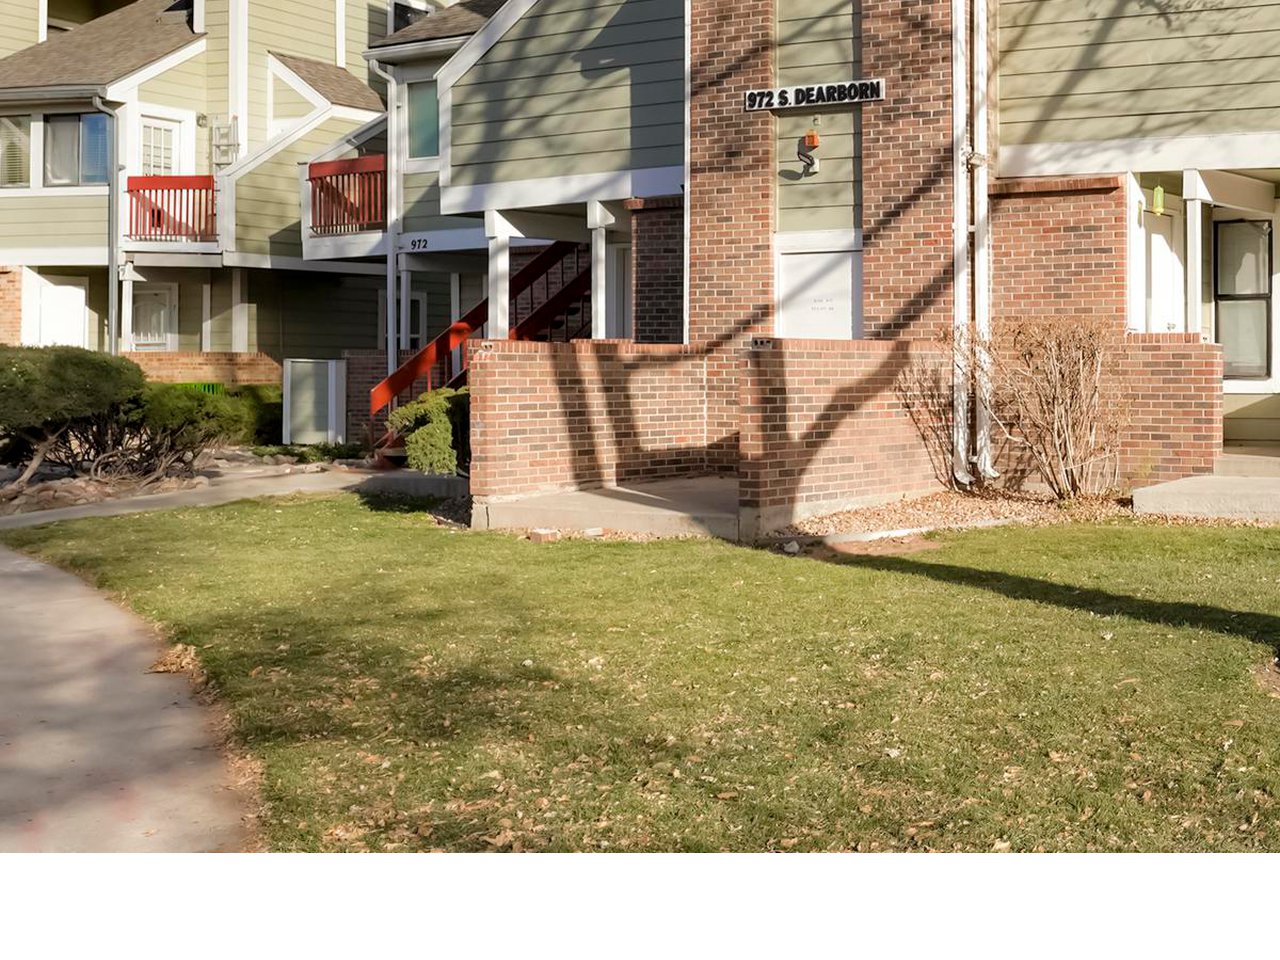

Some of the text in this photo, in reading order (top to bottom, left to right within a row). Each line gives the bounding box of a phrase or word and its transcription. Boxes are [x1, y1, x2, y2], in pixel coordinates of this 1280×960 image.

[747, 80, 881, 109] 972 S. DEARBORN
[411, 238, 428, 250] 972
